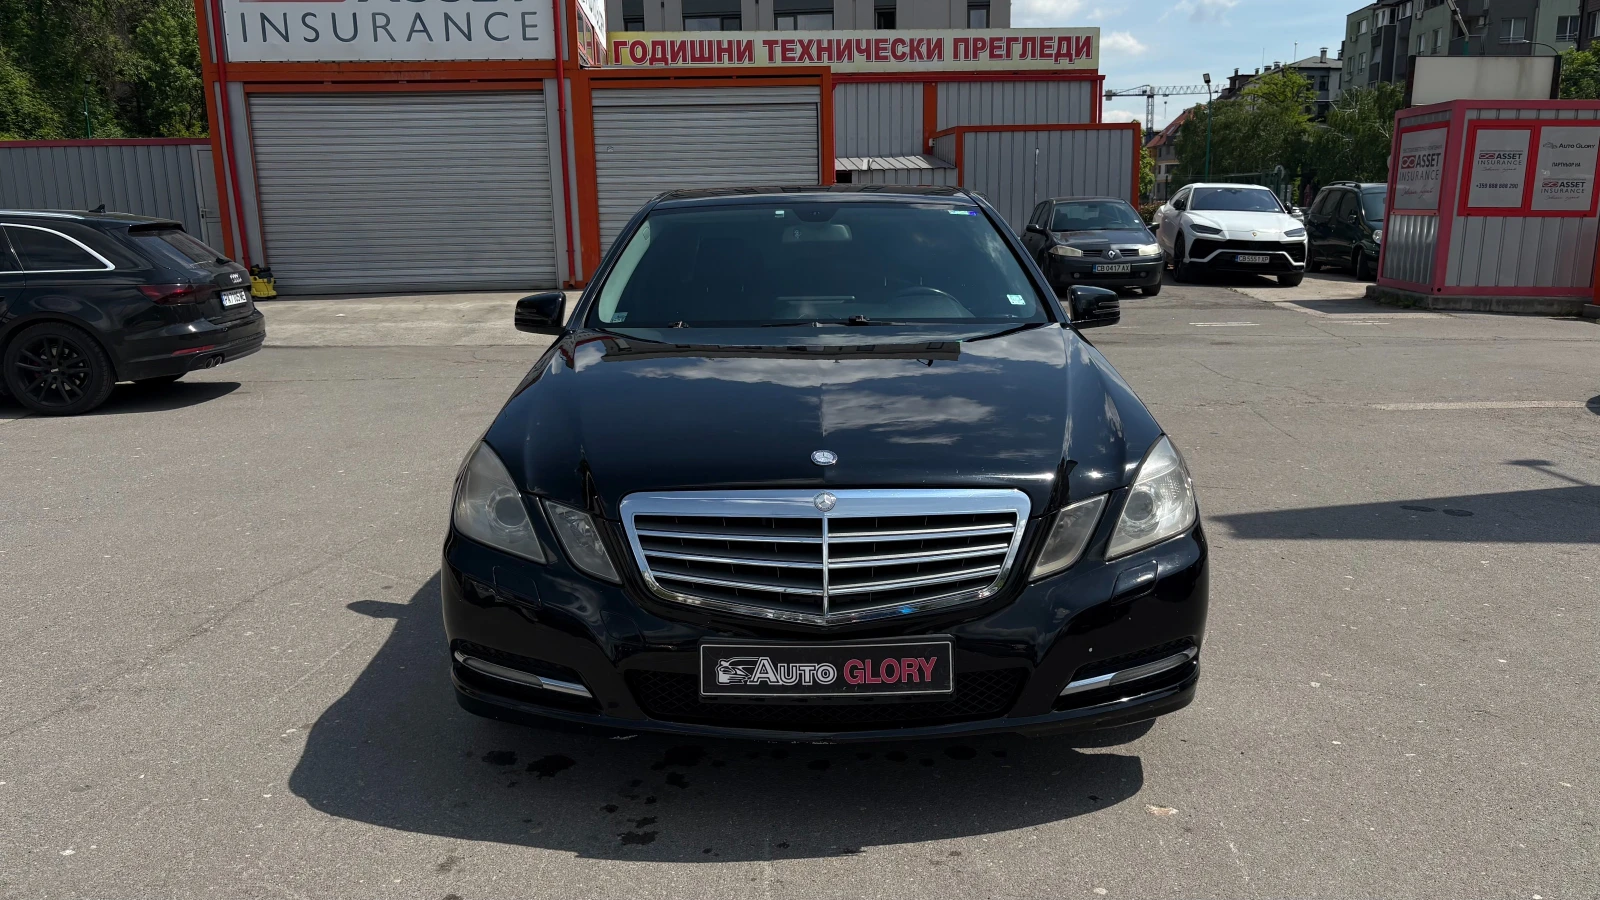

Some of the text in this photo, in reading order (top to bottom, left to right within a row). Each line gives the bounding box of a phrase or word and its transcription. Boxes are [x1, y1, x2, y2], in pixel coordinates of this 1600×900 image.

[240, 11, 540, 43] INSURANCE
[613, 35, 1093, 66] ГОДИШНИ ТЕХНИЧЕСКИ ПРЕГЛЕДИ
[1415, 152, 1442, 168] ASSET
[1495, 152, 1523, 160] ASSET
[1399, 169, 1440, 182] INSURANCE
[843, 657, 937, 684] GLORY
